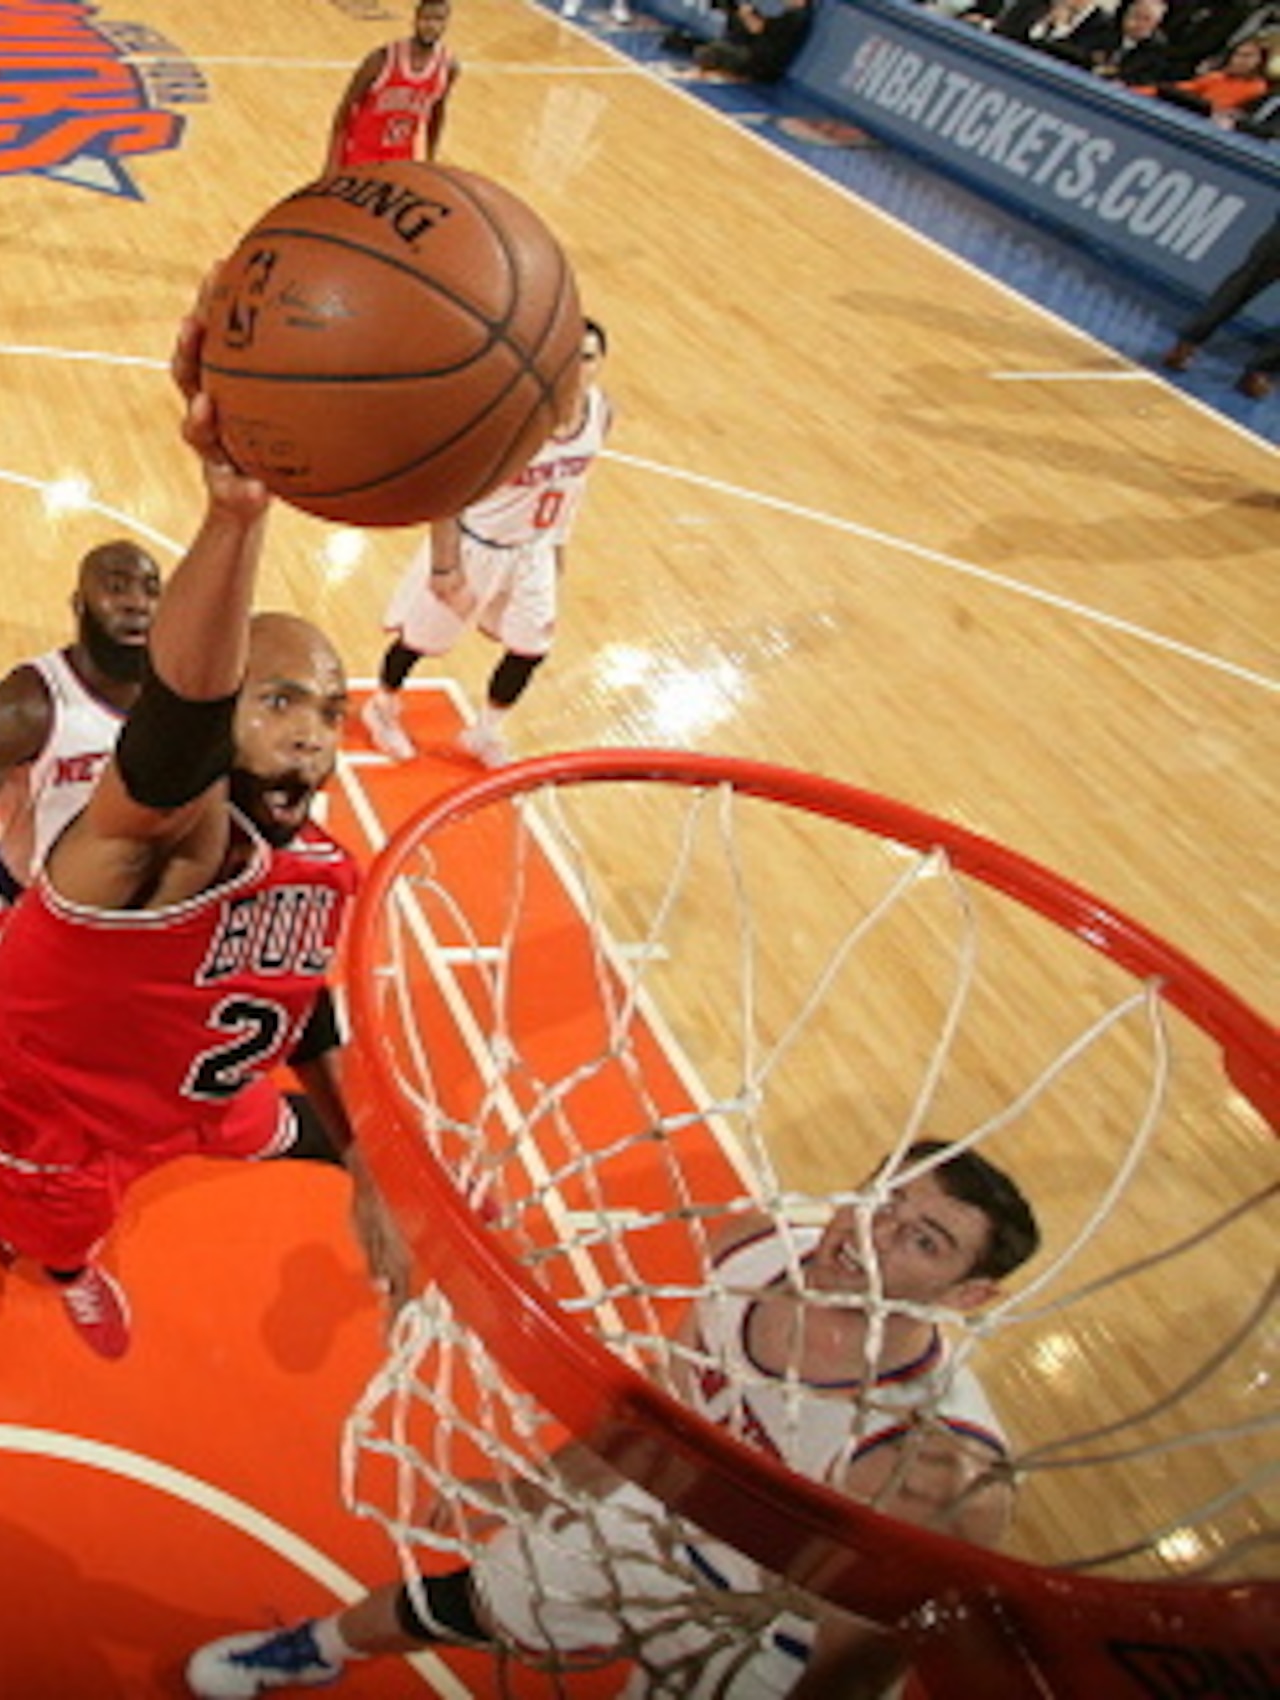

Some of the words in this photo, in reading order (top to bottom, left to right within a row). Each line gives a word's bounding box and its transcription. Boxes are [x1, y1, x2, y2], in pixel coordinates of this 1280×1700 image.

[852, 38, 1246, 262] NBATICKETS.COM
[533, 491, 565, 529] 0
[53, 752, 110, 787] NE
[194, 884, 337, 988] BUL
